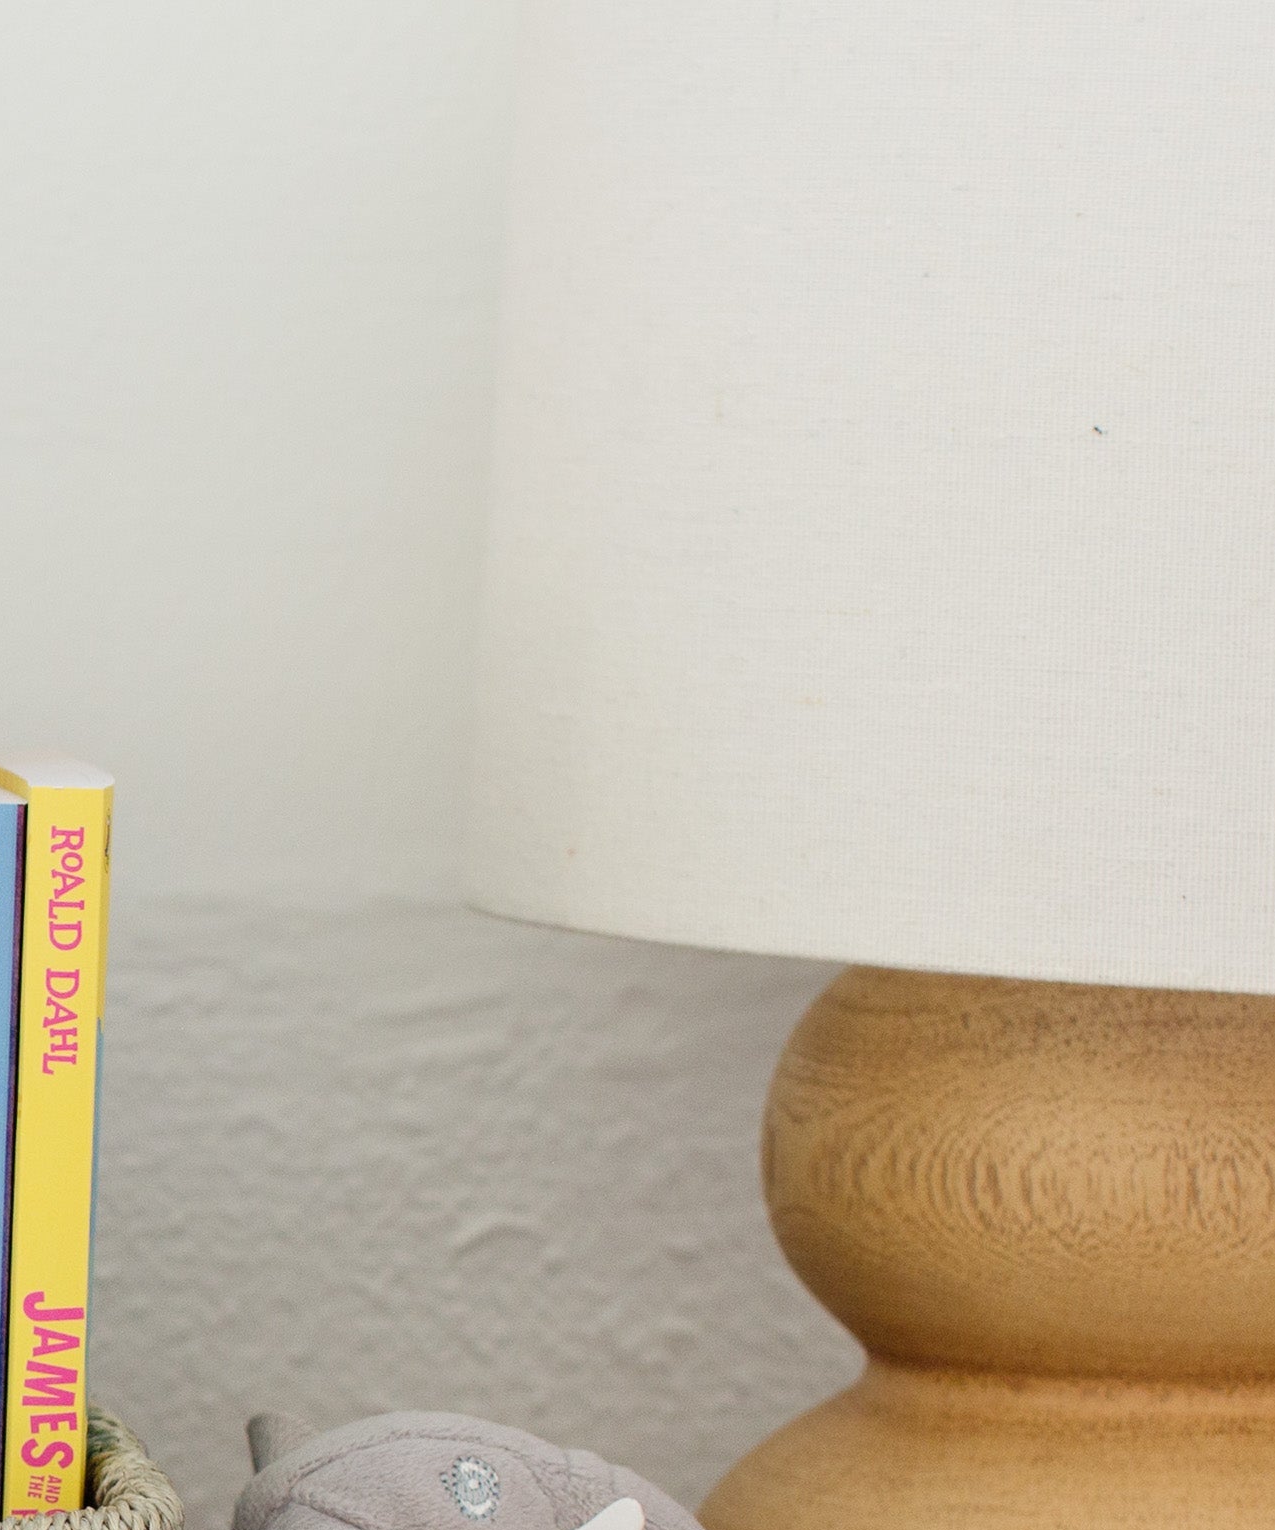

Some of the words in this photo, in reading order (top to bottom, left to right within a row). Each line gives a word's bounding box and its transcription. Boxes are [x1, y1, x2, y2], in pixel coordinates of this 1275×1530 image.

[48, 826, 85, 951] ROALD
[42, 969, 80, 1075] DAHL
[20, 1292, 84, 1470] JAMES
[27, 1476, 44, 1499] THE
[48, 1475, 62, 1503] AND
